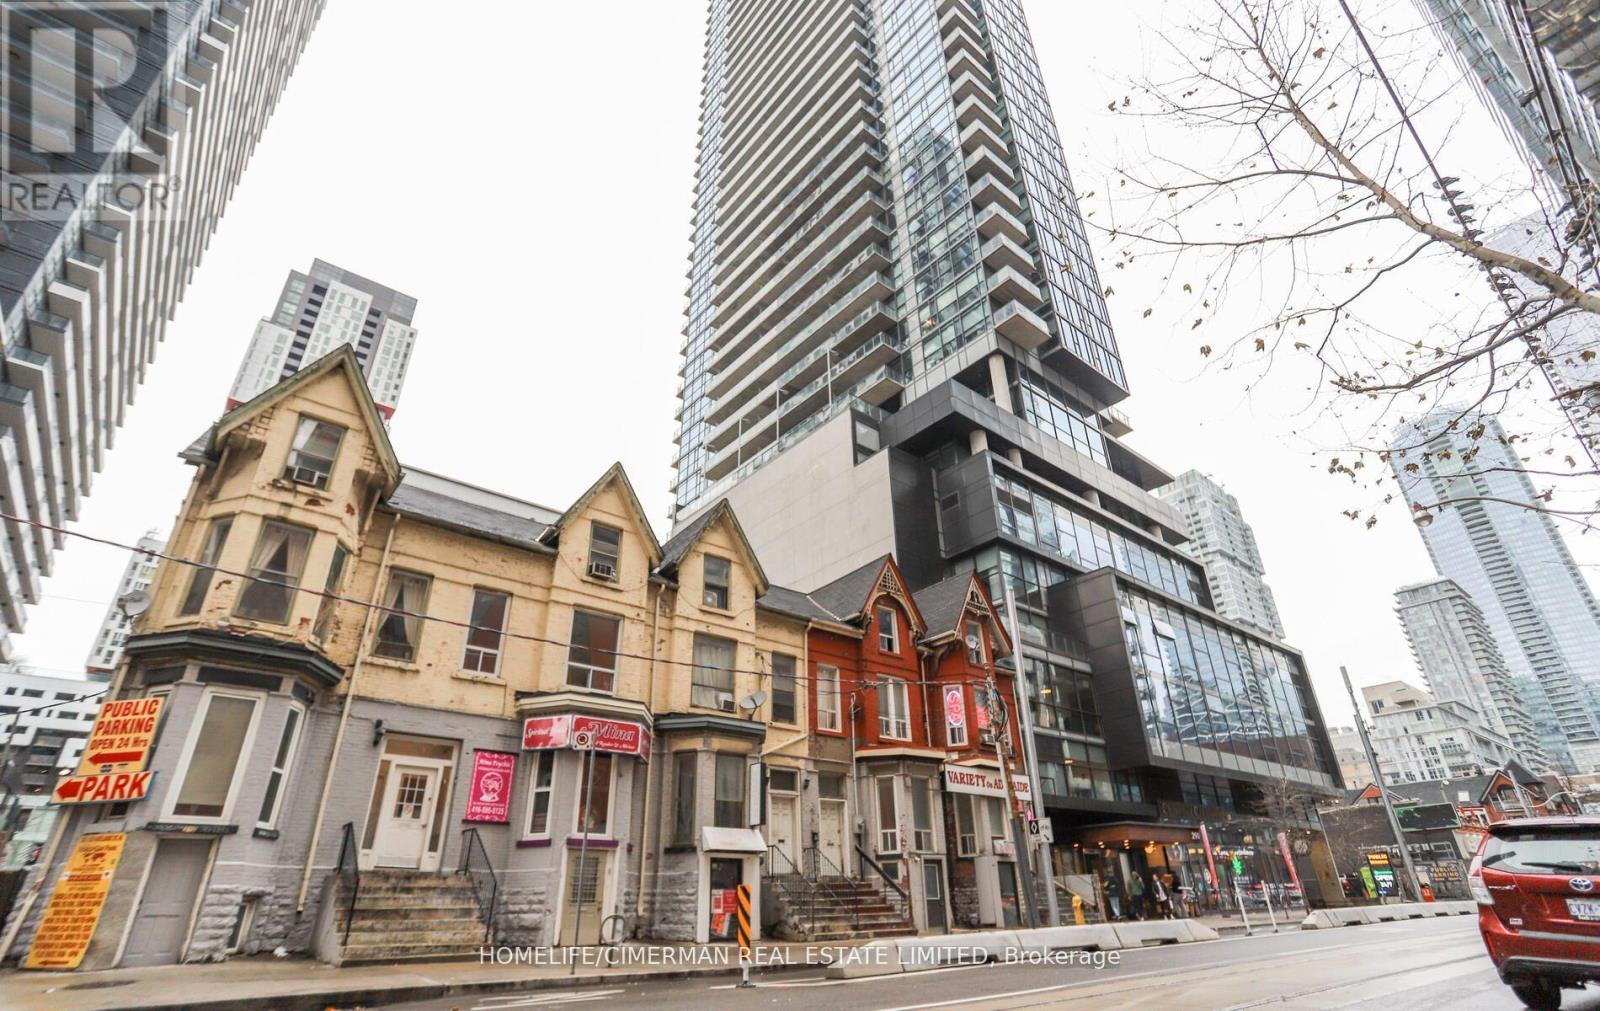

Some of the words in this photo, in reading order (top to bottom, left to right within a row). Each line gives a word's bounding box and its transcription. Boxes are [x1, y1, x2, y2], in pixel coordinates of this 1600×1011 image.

[101, 699, 159, 719] PUBLIC
[94, 717, 155, 737] PARKING
[588, 721, 635, 741] Mina
[89, 738, 115, 750] OPEN
[117, 737, 130, 749] 24
[131, 736, 148, 748] Hrs
[79, 771, 150, 802] PARK
[947, 770, 986, 787] VARIETY
[993, 778, 1029, 793] ADAIDE
